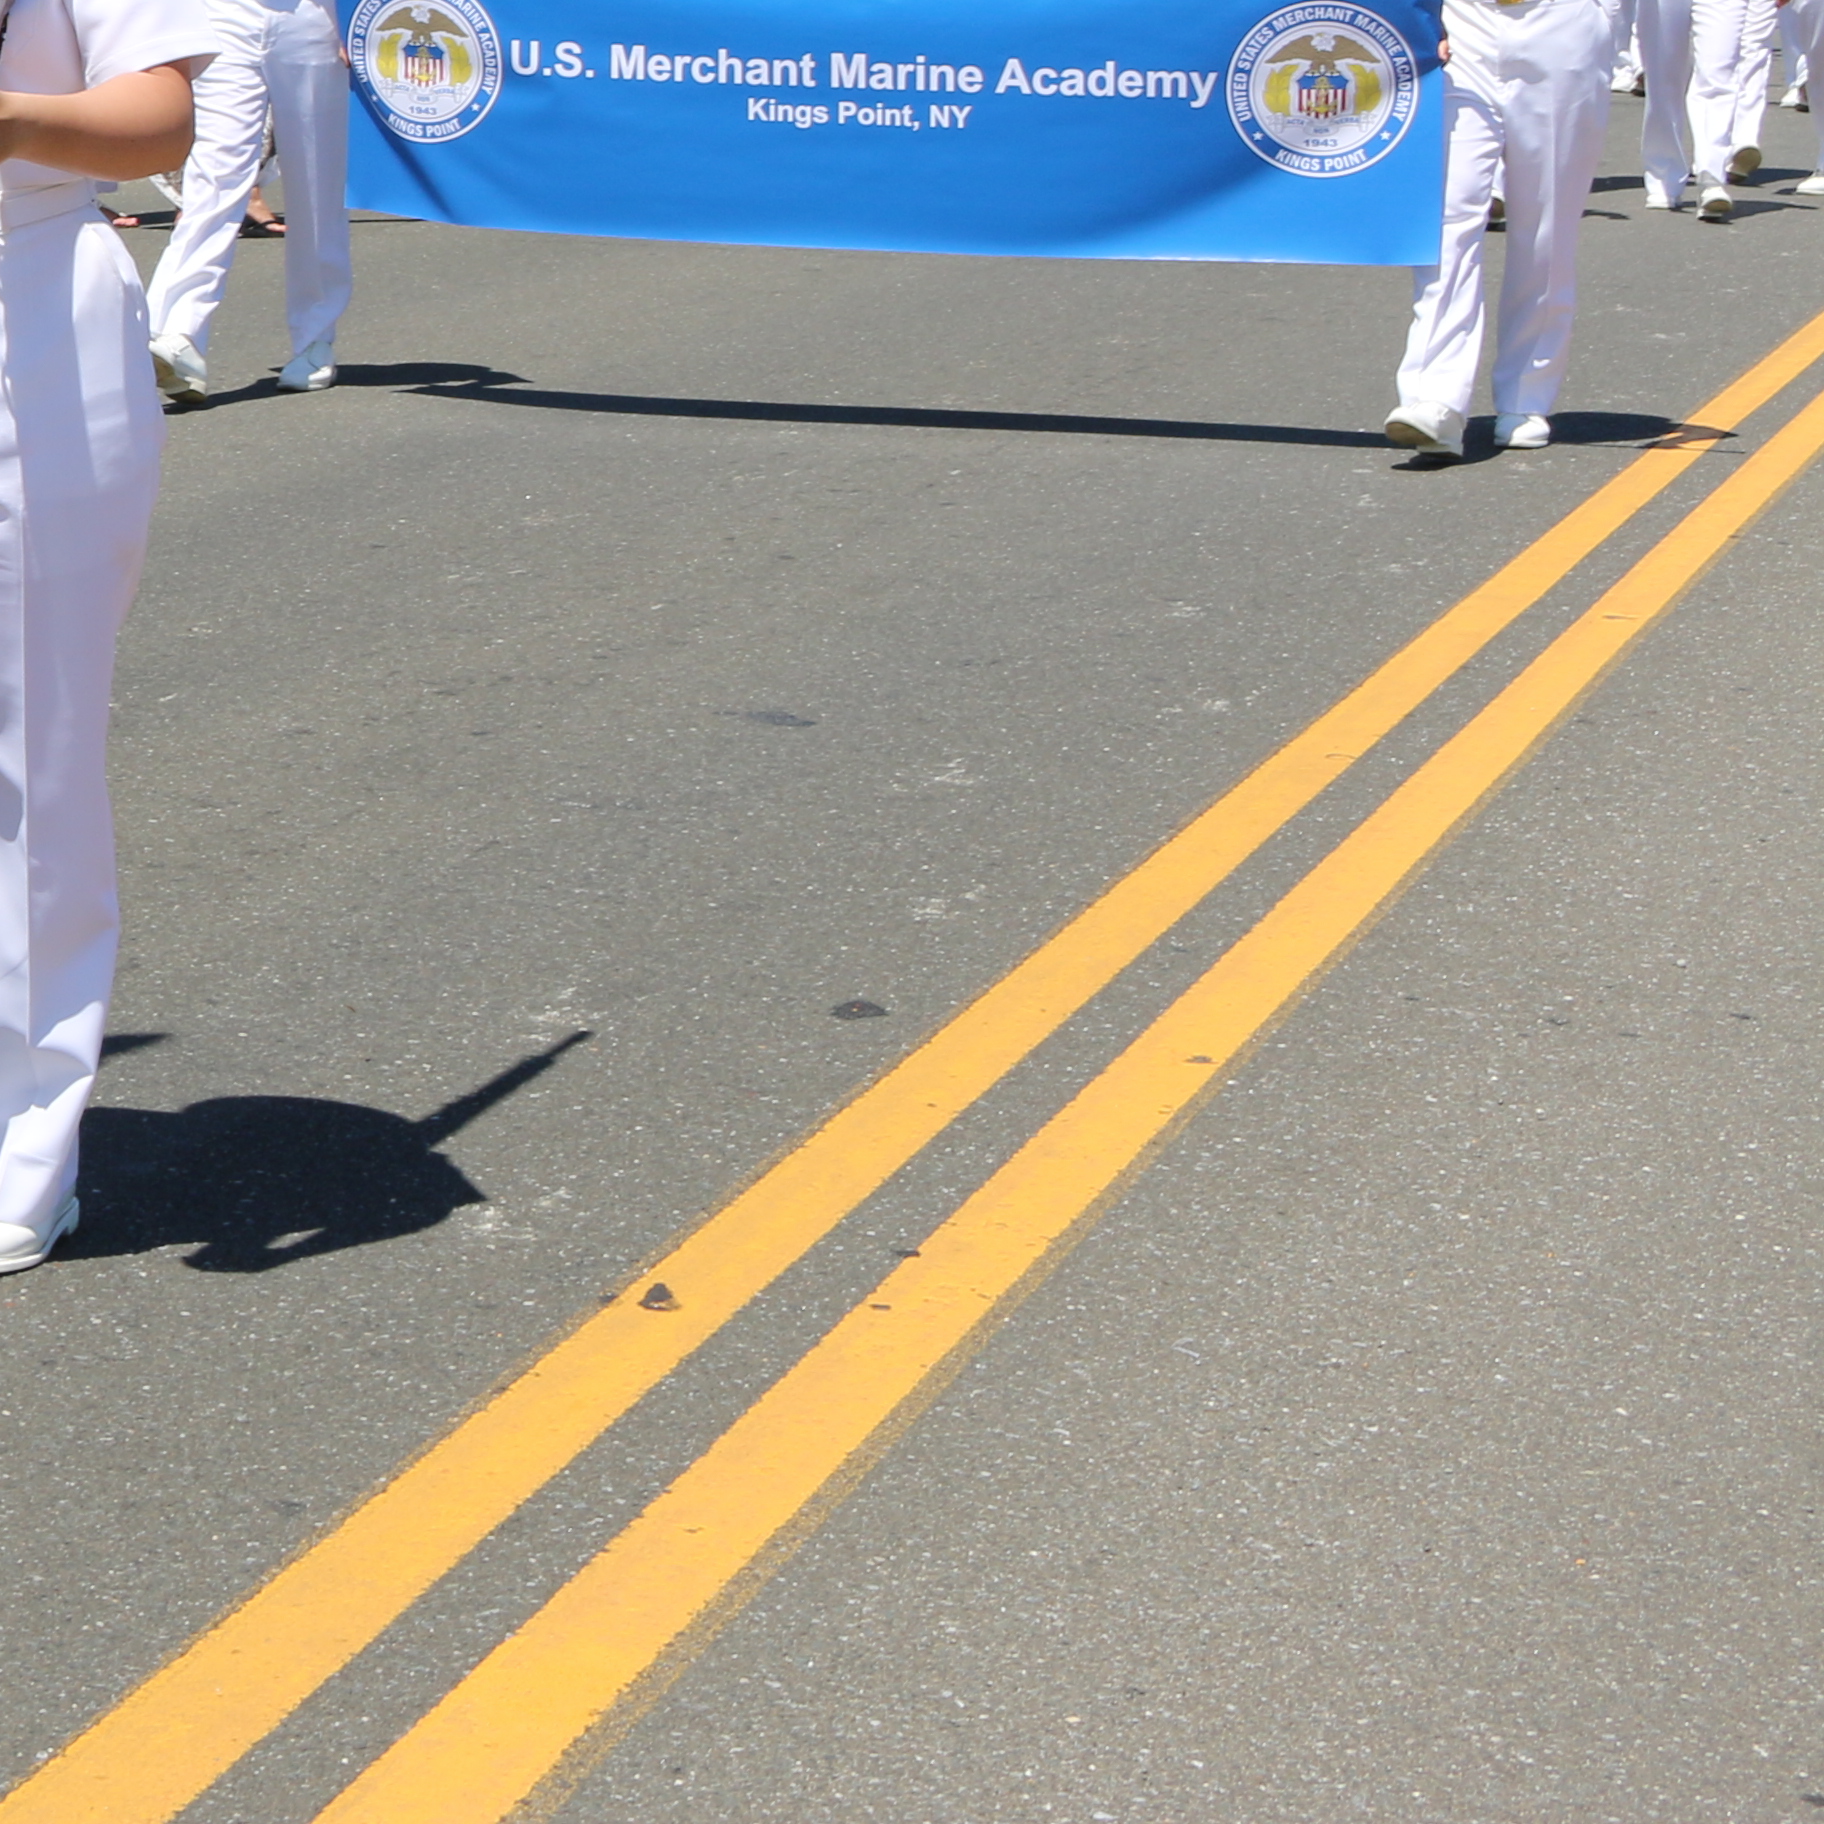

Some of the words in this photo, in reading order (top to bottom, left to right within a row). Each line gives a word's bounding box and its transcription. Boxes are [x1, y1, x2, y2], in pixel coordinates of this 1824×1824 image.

[1272, 7, 1354, 32] MERCHANT
[1353, 14, 1401, 56] MARINE
[352, 38, 368, 83] UNITED
[479, 32, 498, 96] ACADEMY
[1238, 27, 1274, 71] STATES
[510, 39, 595, 78] U.S.
[610, 44, 816, 88] Merchant
[830, 53, 983, 93] Marine
[995, 58, 1217, 108] Academy
[1392, 56, 1413, 123] ACADEMY
[409, 106, 437, 115] 1943
[747, 97, 828, 127] Kings
[837, 102, 920, 131] Point,
[929, 105, 972, 129] NY
[1233, 72, 1251, 122] UNITED
[387, 113, 424, 137] KINGS
[426, 117, 461, 137] POINT
[1303, 138, 1338, 148] 1943
[1275, 149, 1321, 171] KINGS
[1324, 149, 1368, 171] POINT
